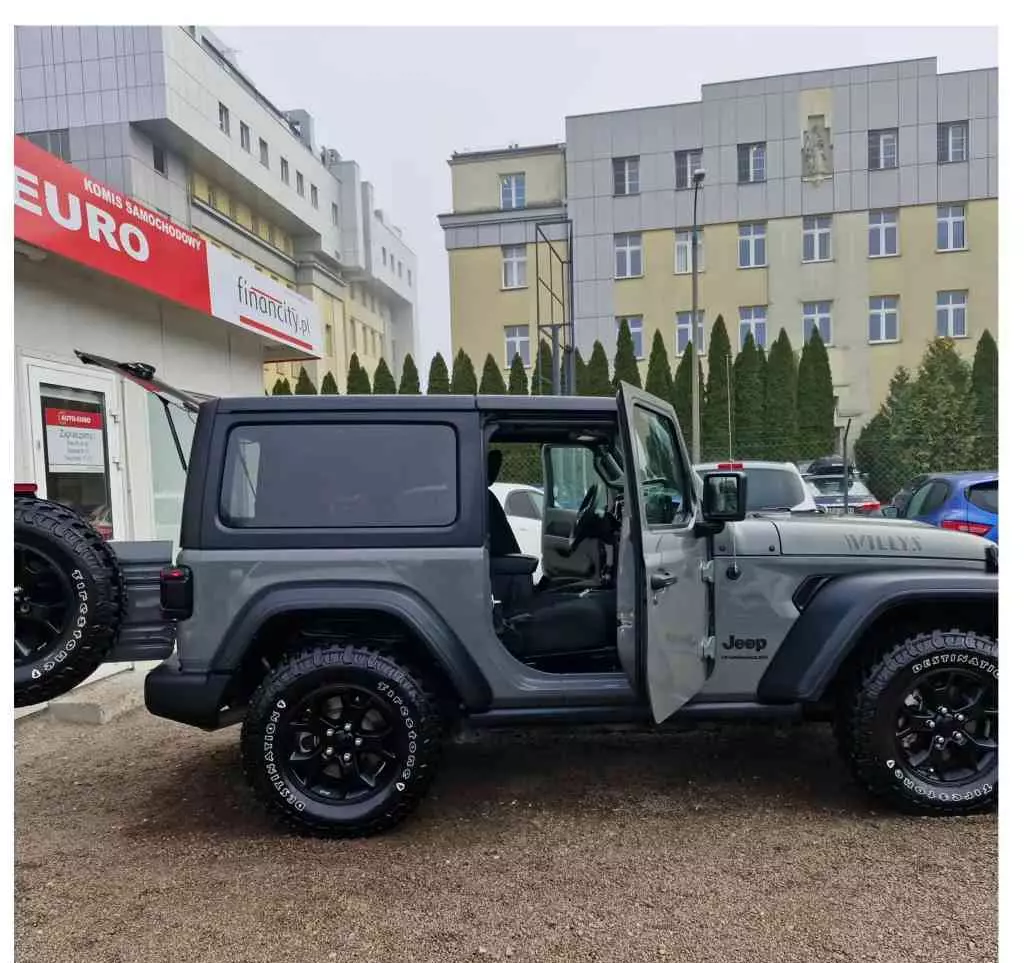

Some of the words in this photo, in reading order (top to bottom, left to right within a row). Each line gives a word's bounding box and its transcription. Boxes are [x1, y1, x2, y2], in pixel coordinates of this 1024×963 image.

[83, 177, 123, 210] KOMIS
[126, 197, 202, 252] SAMOCHODOWY
[237, 275, 311, 337] financity.pl
[844, 533, 923, 552] WILLYS
[722, 635, 768, 651] Jeep
[263, 711, 306, 812] DESTINATION
